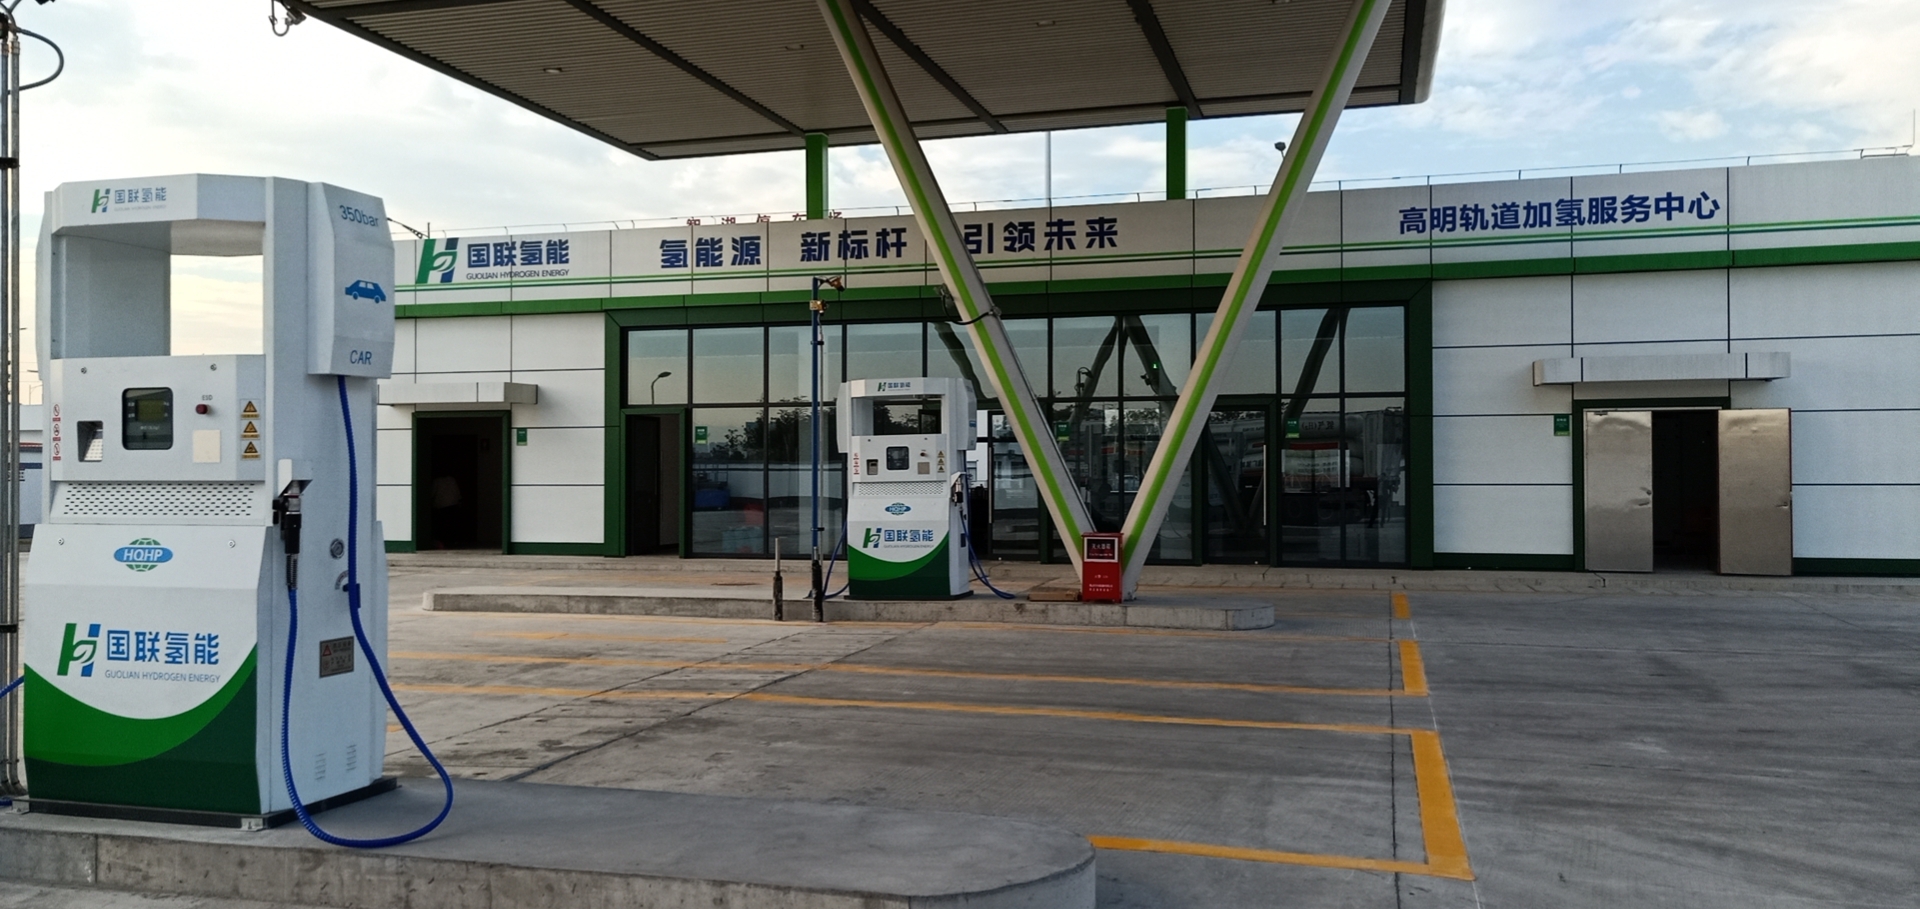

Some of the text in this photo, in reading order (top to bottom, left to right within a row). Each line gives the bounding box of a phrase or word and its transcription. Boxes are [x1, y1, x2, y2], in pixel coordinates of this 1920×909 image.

[114, 186, 167, 204] 国联氢能
[339, 204, 379, 227] 350bar
[1399, 191, 1721, 234] 高明轨道加氢服务中心
[659, 216, 1119, 269] 氢能源 新标杆 引领未来
[467, 239, 570, 268] 国联氢能
[466, 268, 570, 280] GUOLIAN HYDROGEN ENERGY
[350, 350, 372, 365] CAR
[123, 548, 164, 562] HQHP
[106, 629, 220, 666] 国联氢能
[105, 669, 221, 684] GUOLIAN HYDROGEN ENERGY
